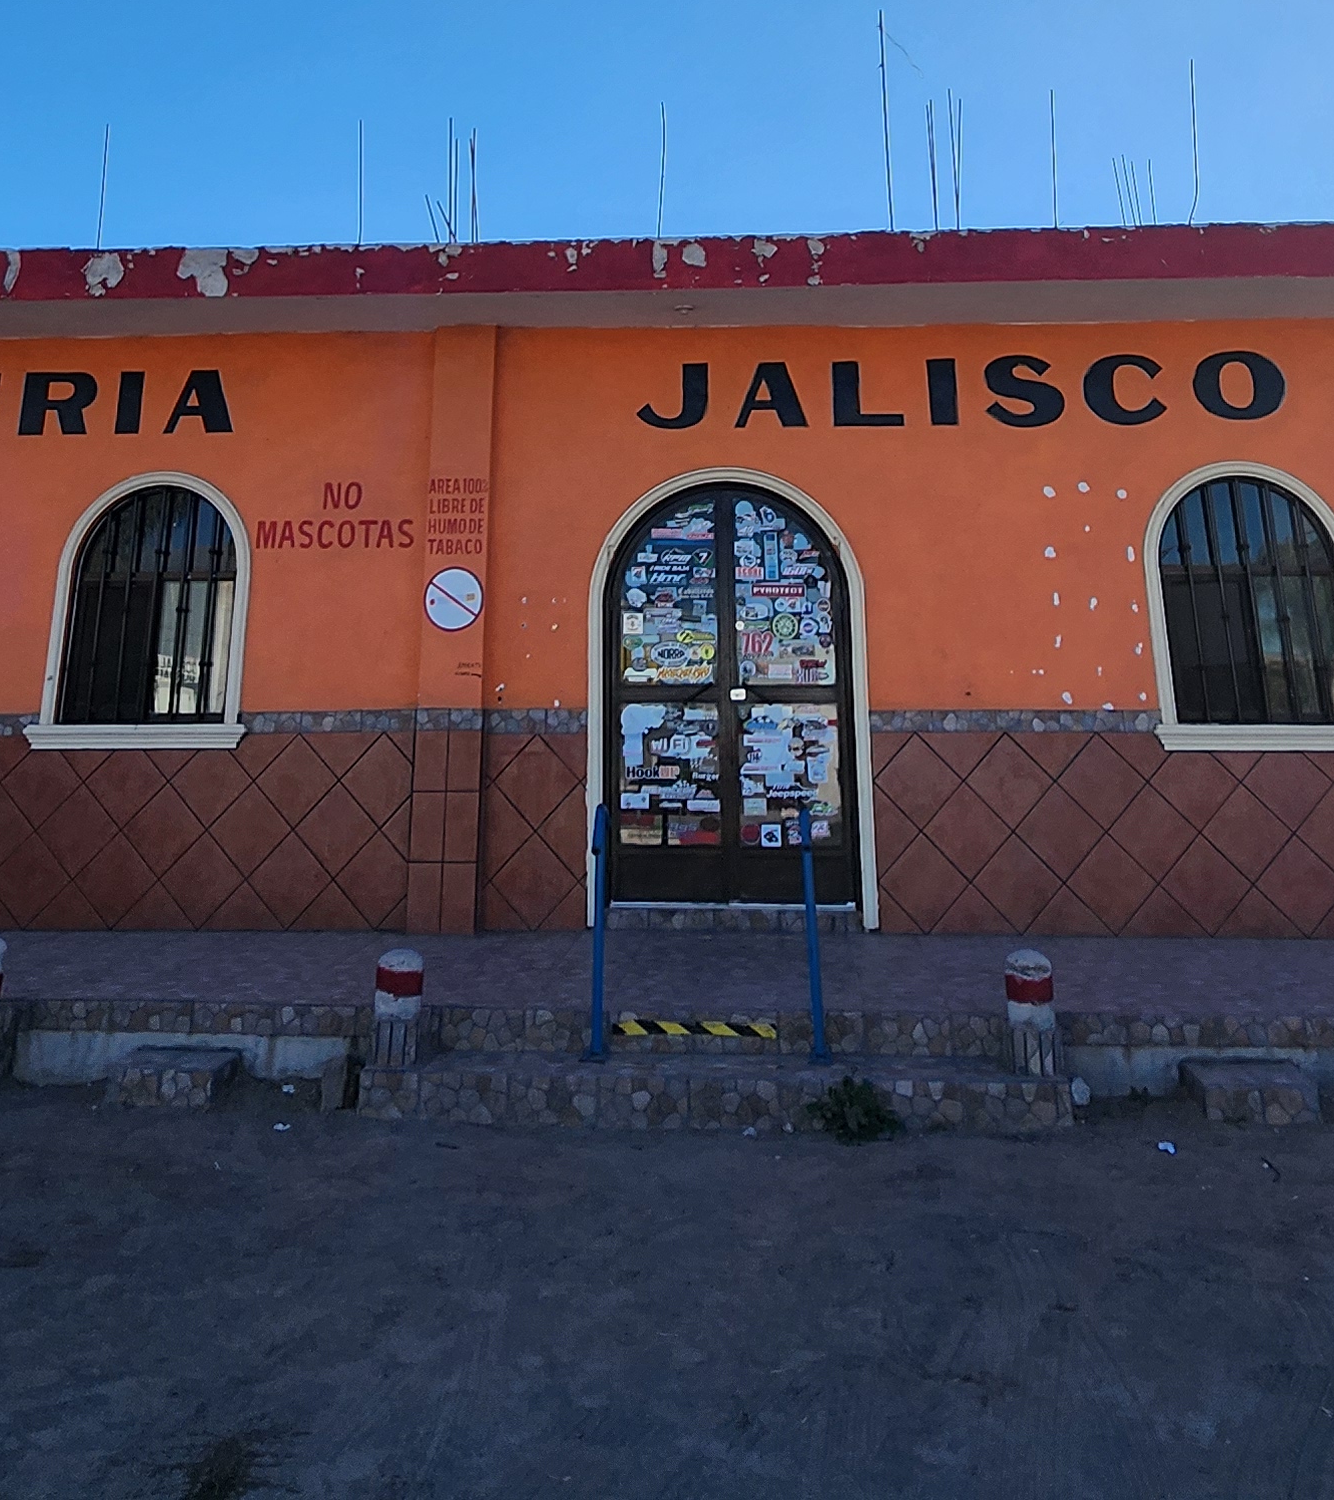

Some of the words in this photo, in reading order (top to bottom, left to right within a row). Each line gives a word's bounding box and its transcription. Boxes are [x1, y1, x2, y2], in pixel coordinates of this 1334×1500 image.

[636, 350, 1286, 429] JALISCO
[323, 481, 363, 510] NO
[429, 478, 461, 494] AREA
[429, 498, 466, 514] LIBRE
[470, 497, 485, 514] DE
[255, 519, 415, 549] MASCOTAS
[428, 518, 467, 534] HUMO
[469, 518, 484, 534] DE
[427, 539, 482, 555] TABACO
[741, 631, 774, 654] 762
